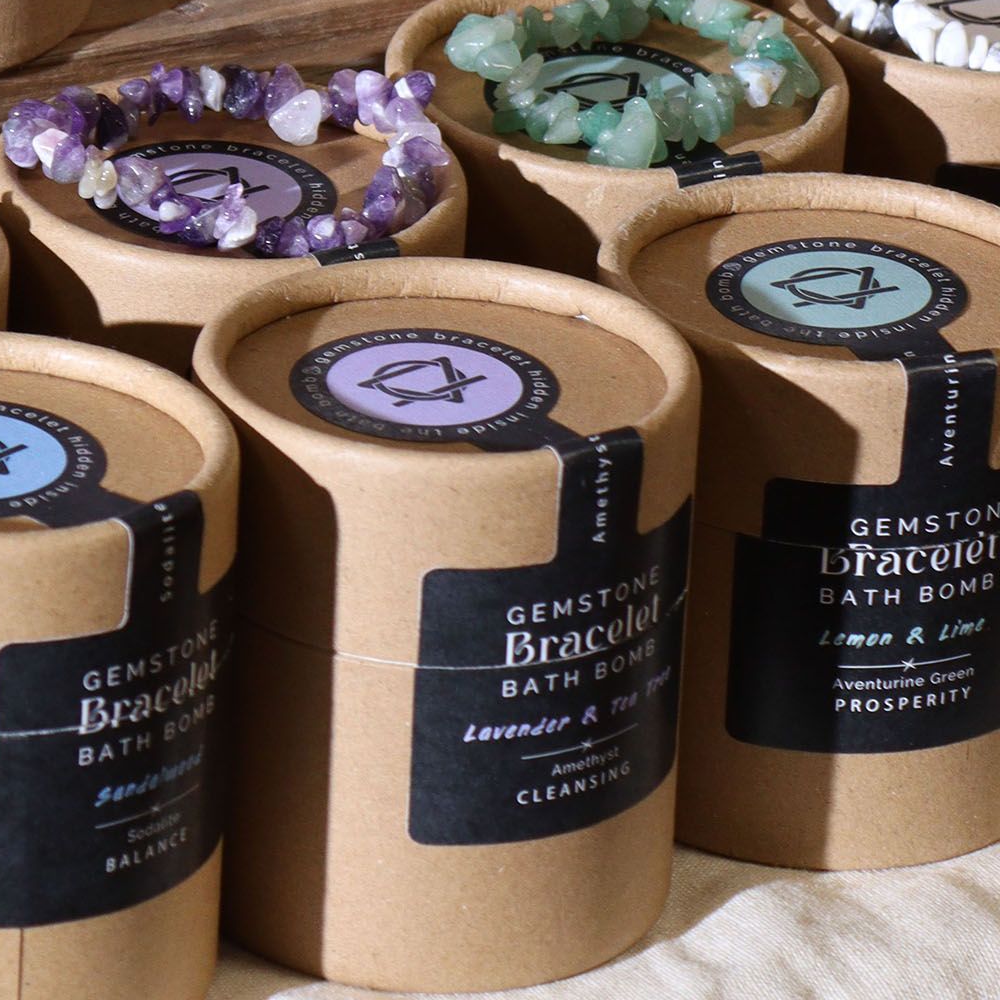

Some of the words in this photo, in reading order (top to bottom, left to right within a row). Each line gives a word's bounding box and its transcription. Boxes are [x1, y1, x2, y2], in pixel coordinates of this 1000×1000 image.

[226, 144, 314, 180] bracelet
[742, 240, 857, 264] gemstone
[870, 243, 952, 283] bracelet
[717, 270, 736, 302] bomb
[731, 304, 771, 328] bath
[918, 286, 959, 324] hidden
[315, 331, 419, 365] gemstone
[783, 326, 823, 339] the
[838, 322, 915, 341] inside
[434, 332, 533, 368] bracelet
[301, 376, 330, 409] bomb
[525, 369, 551, 410] hidden
[457, 412, 529, 436] inside
[938, 353, 961, 468] Aventurin
[399, 427, 442, 438] the
[67, 434, 95, 479] hidden
[9, 482, 78, 509] inside
[588, 434, 613, 544] Amethyst
[850, 502, 1000, 538] GEMSTON
[819, 530, 999, 578] Bracelet
[506, 565, 662, 627] GEMSTONE
[819, 586, 901, 608] BATH
[918, 572, 995, 604] BOMB
[505, 593, 660, 668] Bracelet
[818, 626, 893, 648] Lemon
[906, 625, 925, 646] &
[939, 617, 986, 643] Lime
[82, 618, 219, 692] GEMSTONE
[502, 670, 580, 699] BATH
[594, 638, 657, 681] BOMB
[78, 649, 218, 735] Bracelet
[832, 673, 926, 691] Aventurine
[929, 664, 976, 686] Green
[835, 686, 973, 713] PROSPERITY
[77, 734, 152, 767] BATH
[163, 694, 217, 743] BOMB
[462, 713, 571, 744] Lavender
[581, 704, 599, 726] &
[551, 745, 620, 778] Amethyst
[516, 761, 632, 806] CLEANSING
[105, 826, 188, 873] BALANCE
